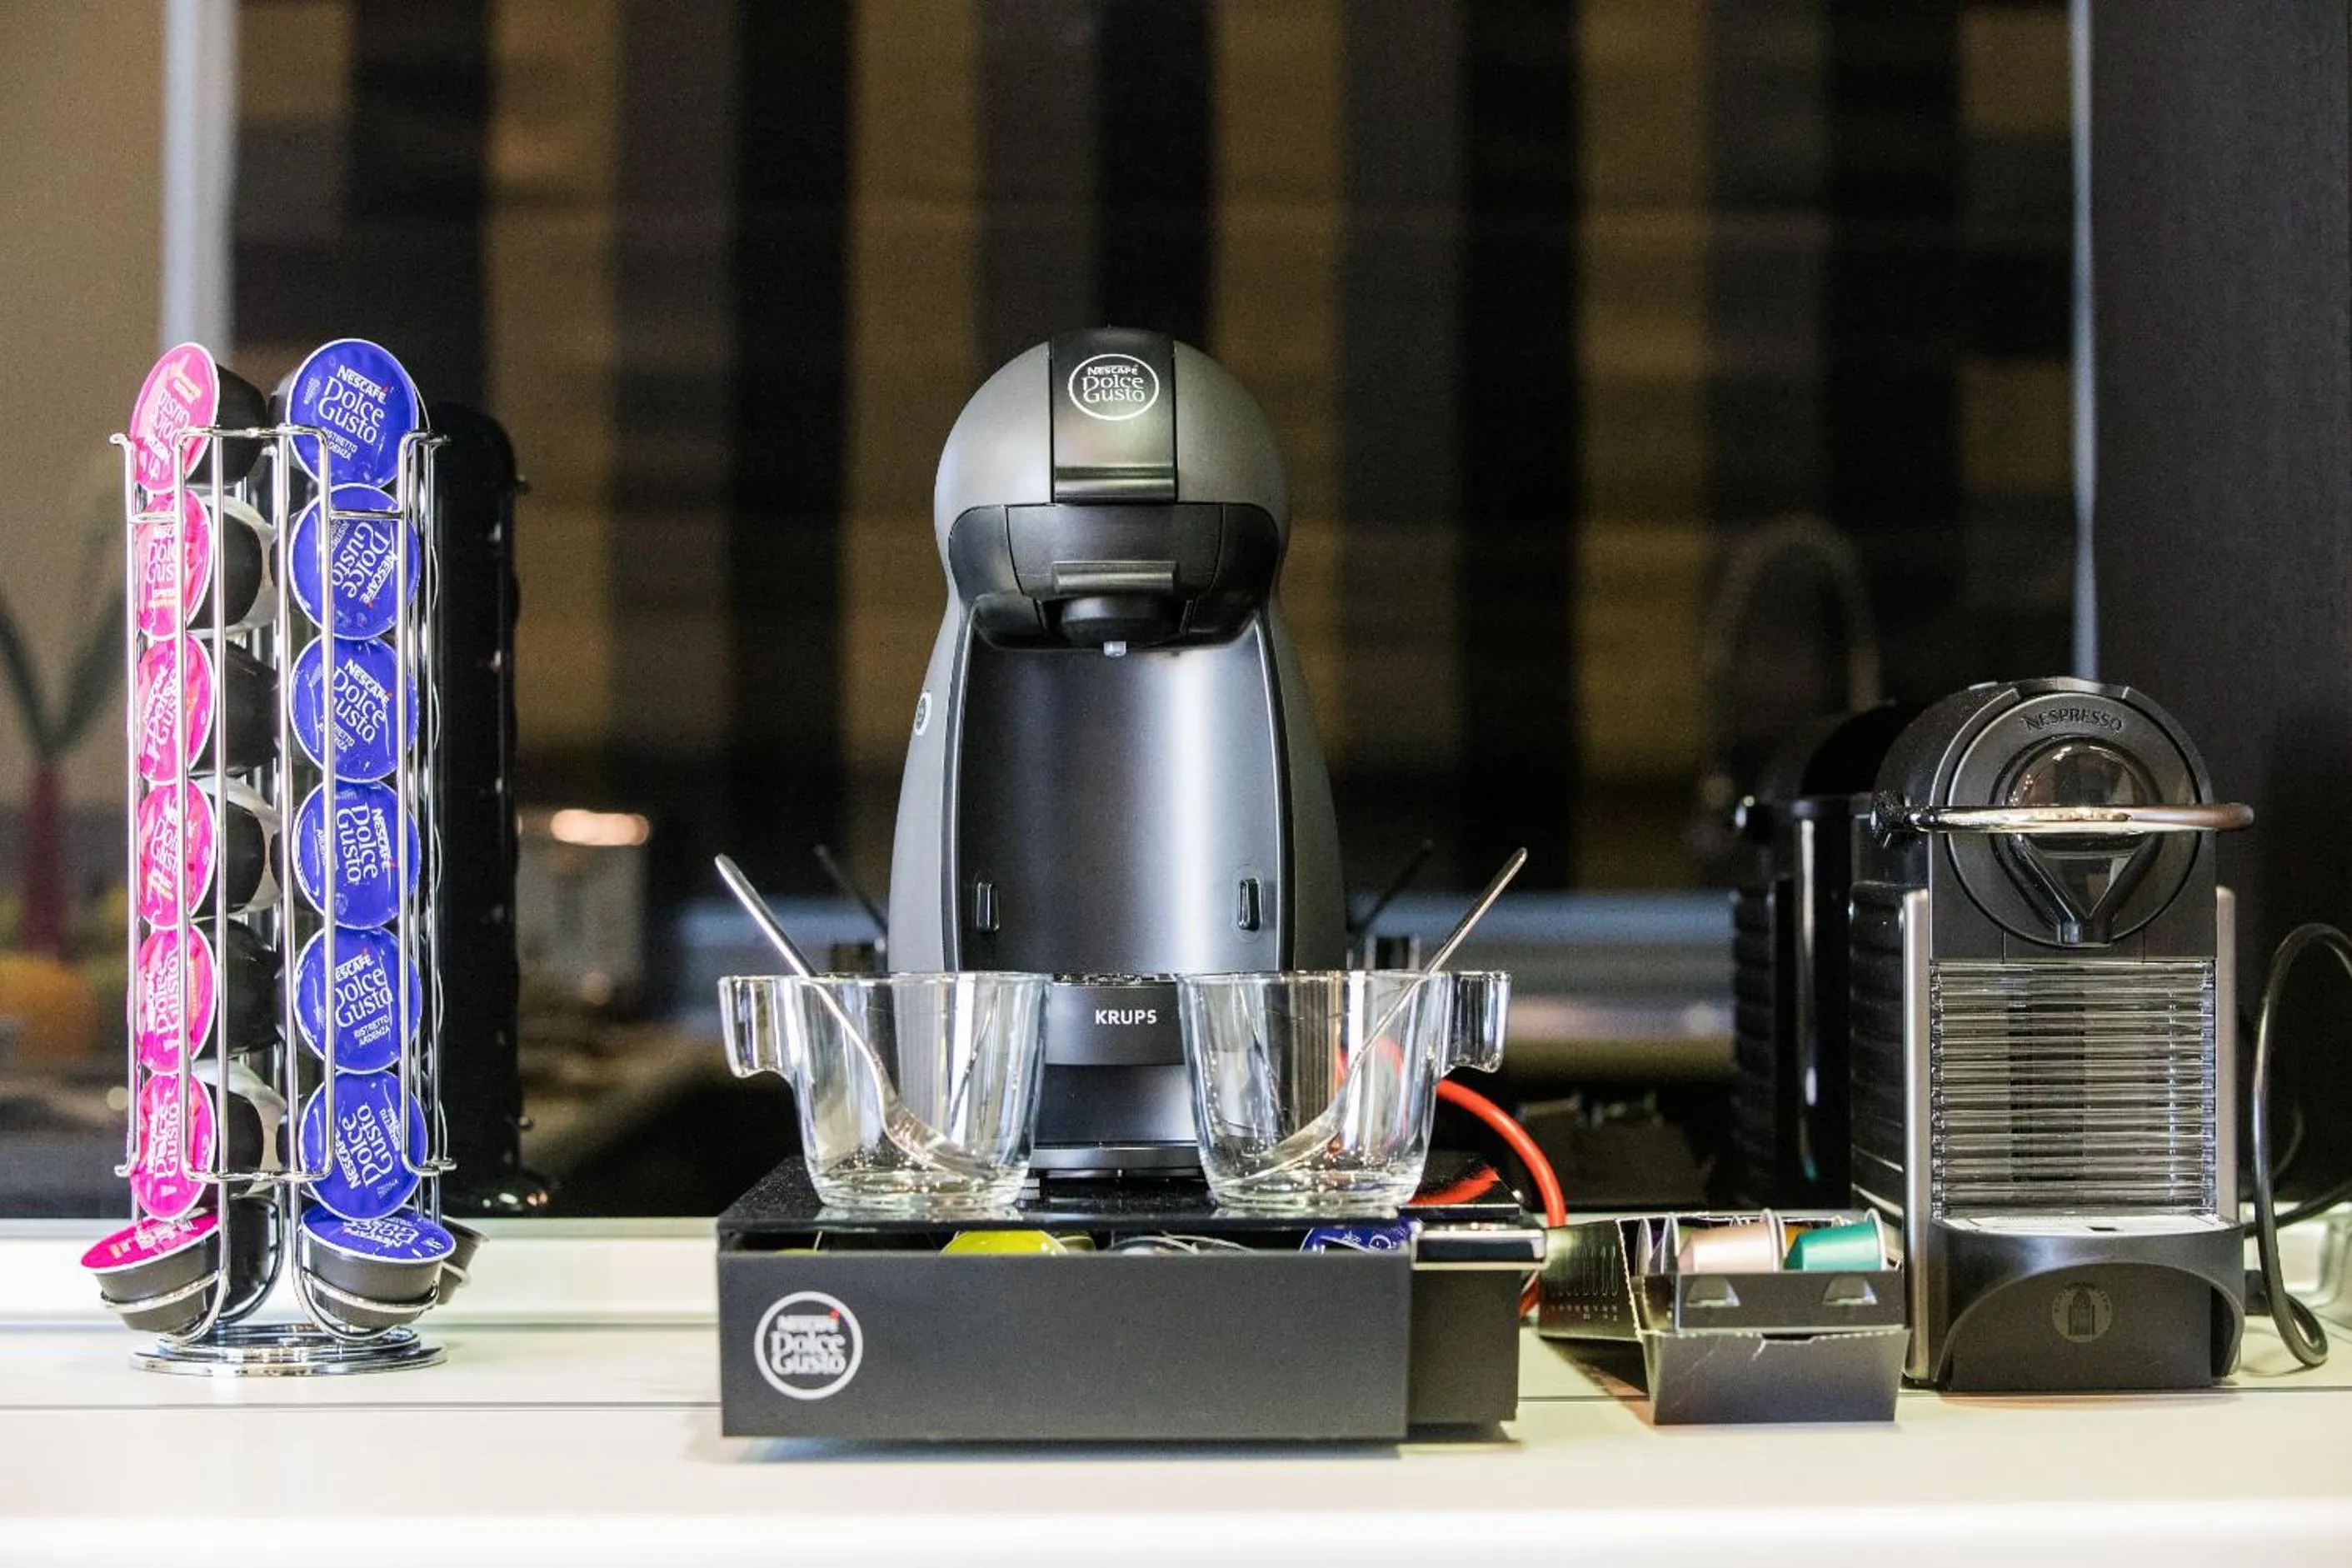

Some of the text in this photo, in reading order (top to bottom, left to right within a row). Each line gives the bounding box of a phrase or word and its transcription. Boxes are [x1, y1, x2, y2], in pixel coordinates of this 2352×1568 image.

[323, 376, 385, 427] Dolce
[1081, 374, 1144, 392] Dolce
[1082, 387, 1146, 403] Gusto
[317, 396, 377, 444] Gusto
[147, 562, 177, 582] Gus
[332, 522, 374, 587] Gusto
[341, 531, 391, 598] Dolce
[333, 667, 387, 728] Dolce
[333, 696, 377, 745] usto
[2020, 707, 2123, 732] NESPRESSO
[337, 807, 362, 883] Gusto
[351, 802, 379, 879] Dolce
[334, 948, 375, 983] ESCAFÉ
[335, 986, 393, 1028] Gusto
[1094, 1009, 1157, 1025] KRUPS
[342, 1111, 382, 1187] Dolce
[357, 1105, 394, 1176] Gusto
